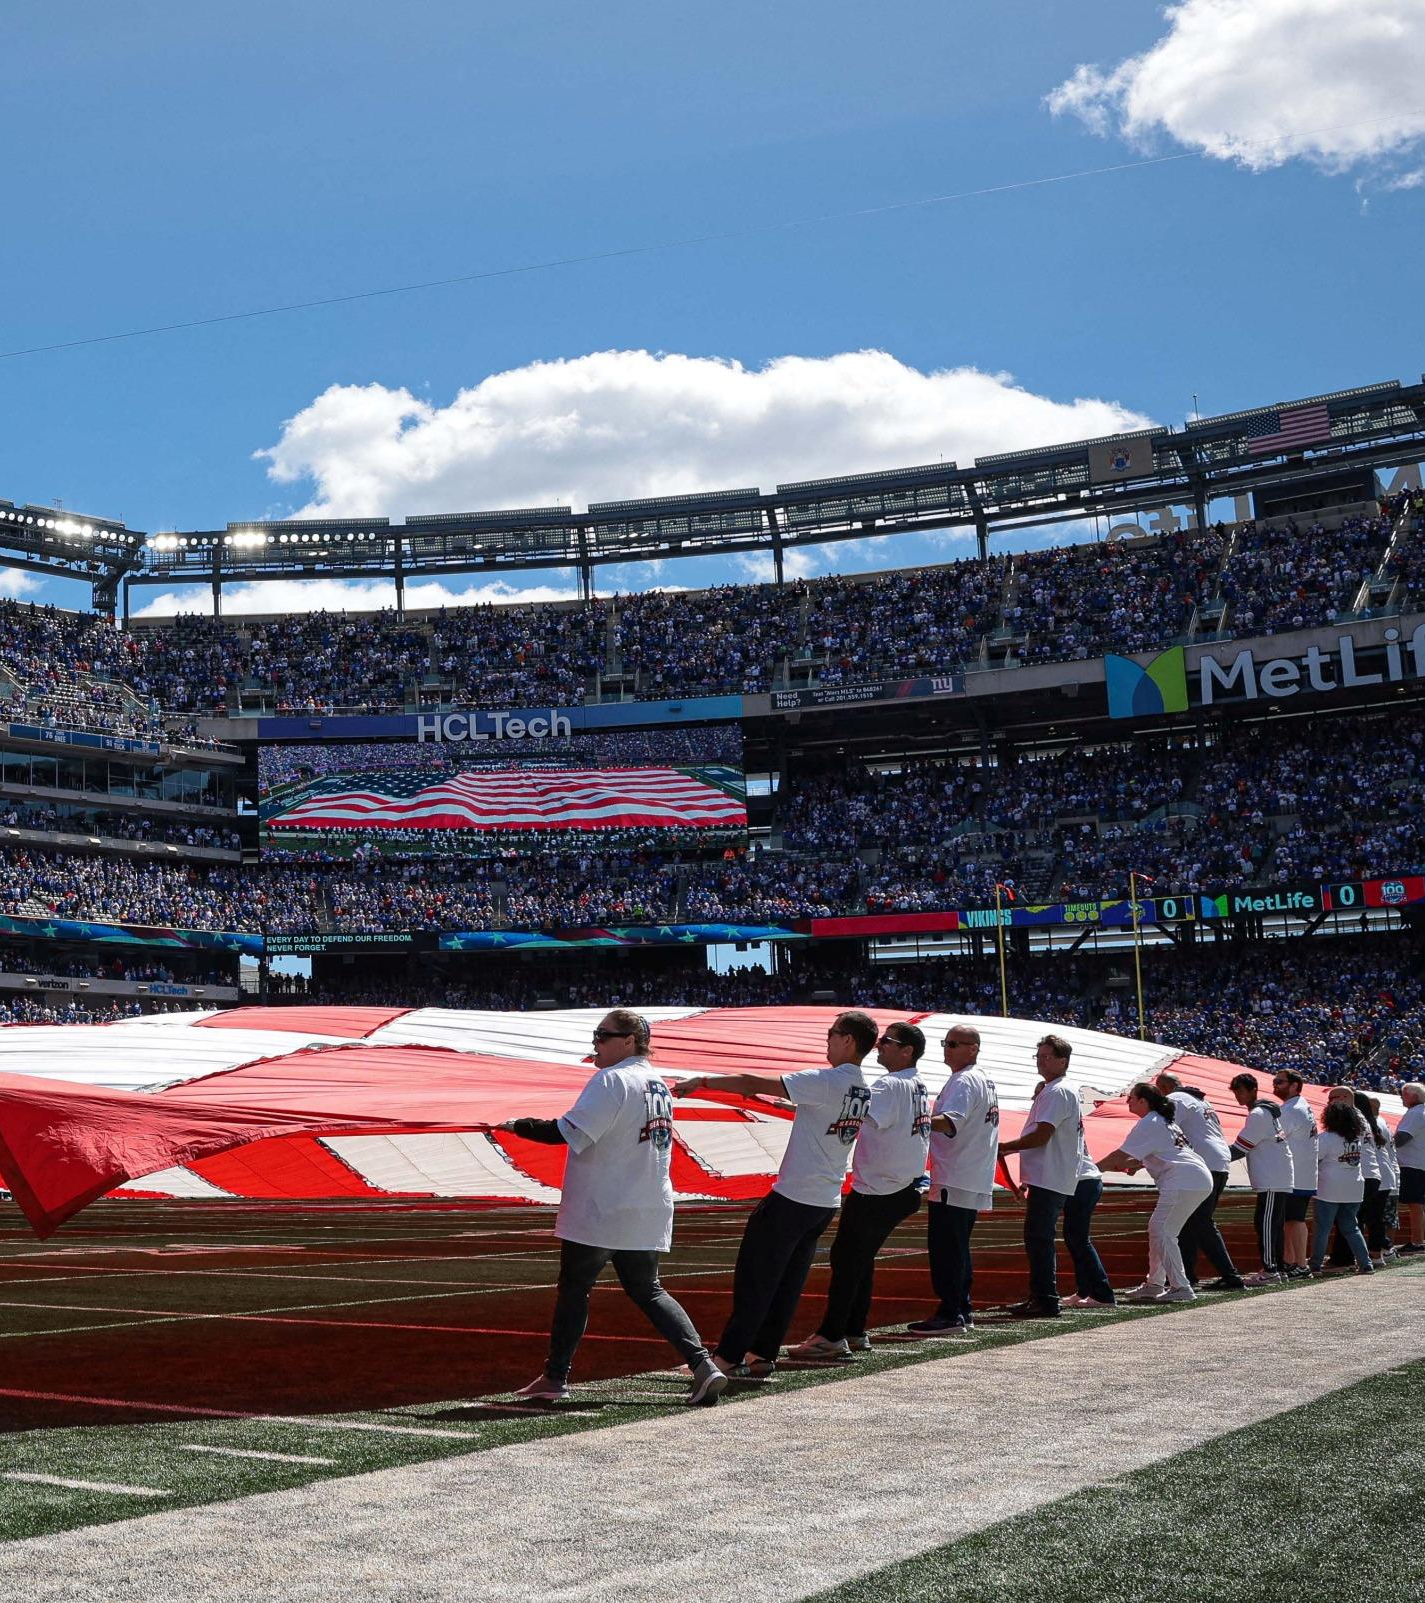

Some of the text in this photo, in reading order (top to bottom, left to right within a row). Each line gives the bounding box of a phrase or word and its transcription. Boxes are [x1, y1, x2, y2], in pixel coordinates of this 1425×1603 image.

[1200, 623, 1425, 705] MetLif
[931, 677, 953, 694] ny
[776, 692, 798, 701] Need
[776, 699, 801, 708] Help?
[417, 709, 572, 743] HCLTech
[1234, 891, 1315, 913] MetLife
[1339, 885, 1355, 906] 0
[1064, 902, 1098, 913] TIMEOUTS
[1163, 899, 1177, 918] 0
[966, 909, 1013, 928] VIKINGS
[266, 936, 292, 944] EVERY
[310, 935, 322, 943] TO
[322, 935, 354, 943] DEFEND
[373, 934, 414, 942] FREEDOM.
[294, 943, 327, 951] FORGET.
[38, 979, 69, 989] verizon
[149, 984, 188, 996] HCLTech
[644, 1092, 673, 1119] 100
[839, 1095, 871, 1120] 100
